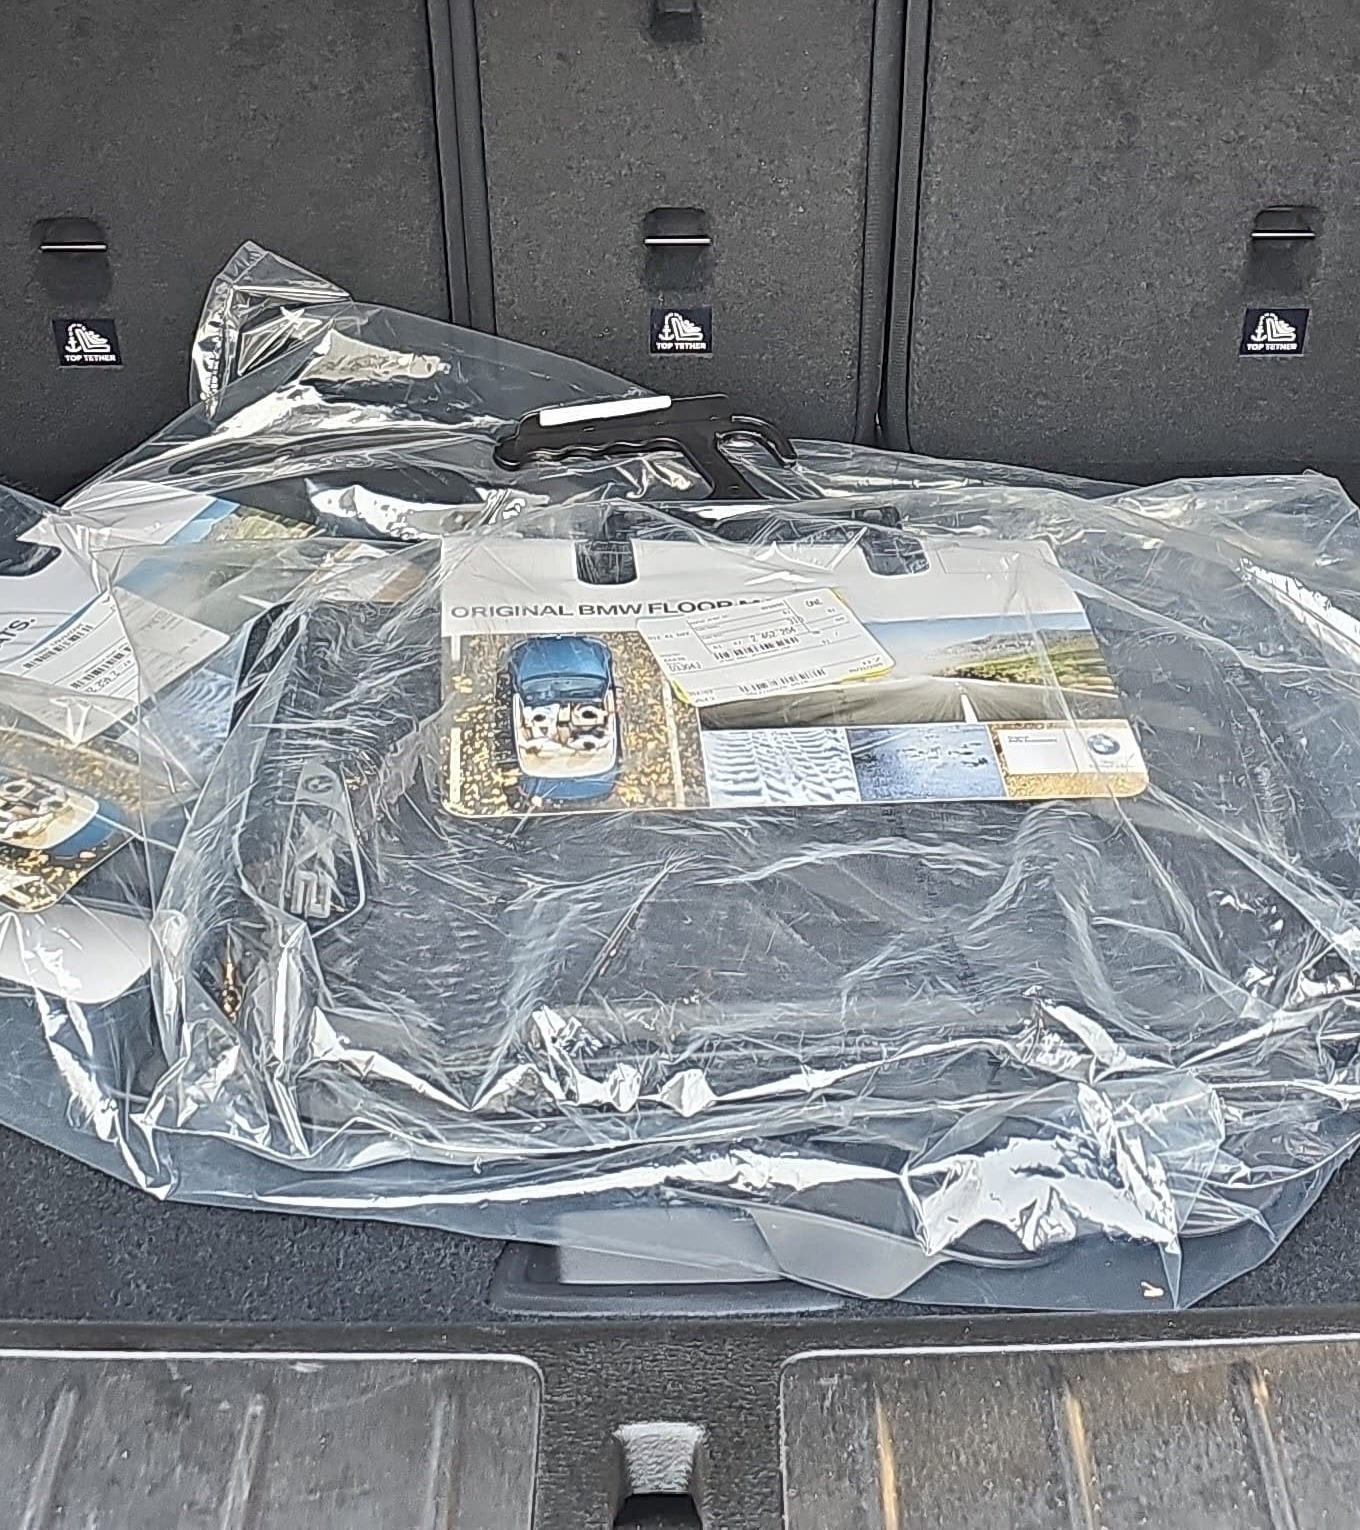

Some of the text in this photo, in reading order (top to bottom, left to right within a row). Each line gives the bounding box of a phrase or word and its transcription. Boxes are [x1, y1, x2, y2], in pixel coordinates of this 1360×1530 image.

[655, 342, 707, 350] TOP TETHER
[1246, 343, 1298, 351] TOP TETHER
[64, 354, 117, 362] TOP TETHER
[450, 604, 574, 619] ORIGINAL
[578, 604, 642, 616] BMW
